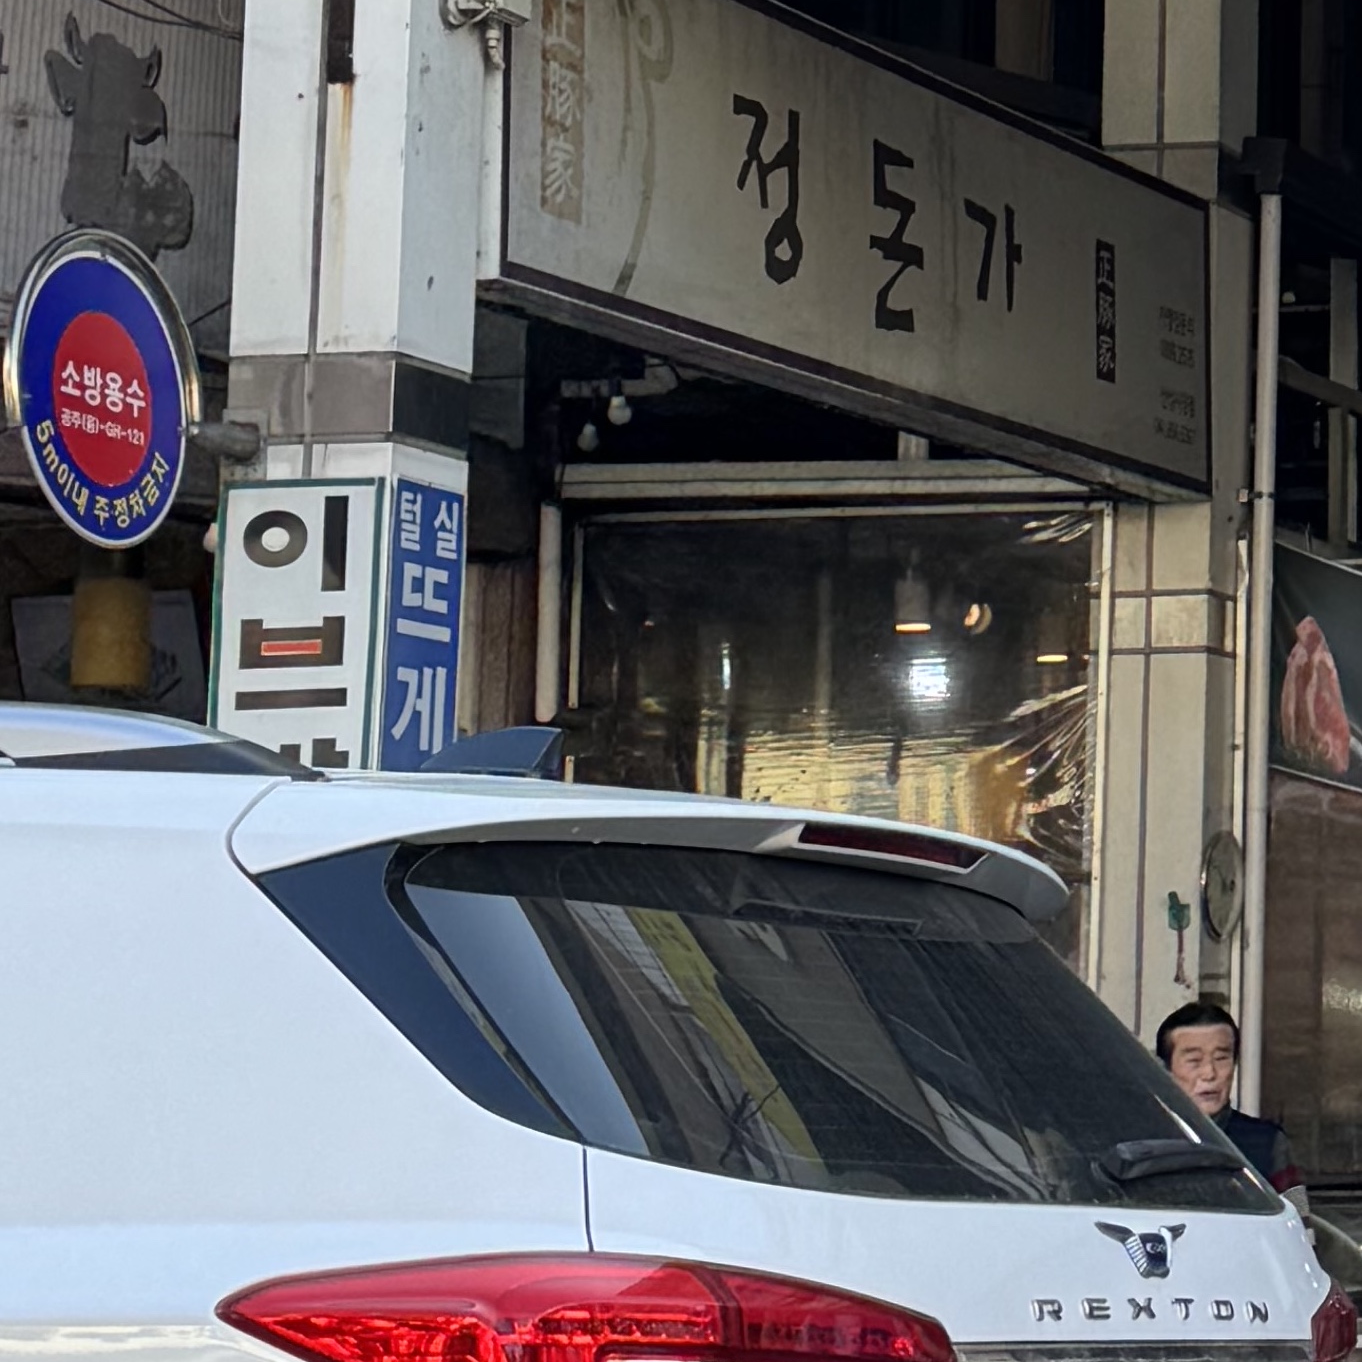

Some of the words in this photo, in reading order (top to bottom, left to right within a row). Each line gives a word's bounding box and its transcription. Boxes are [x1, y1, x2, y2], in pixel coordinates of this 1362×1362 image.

[731, 93, 1023, 333] 정돈가
[60, 360, 147, 418] 소방용수
[398, 490, 458, 560] 털실
[1031, 1298, 1270, 1324] REXTON
